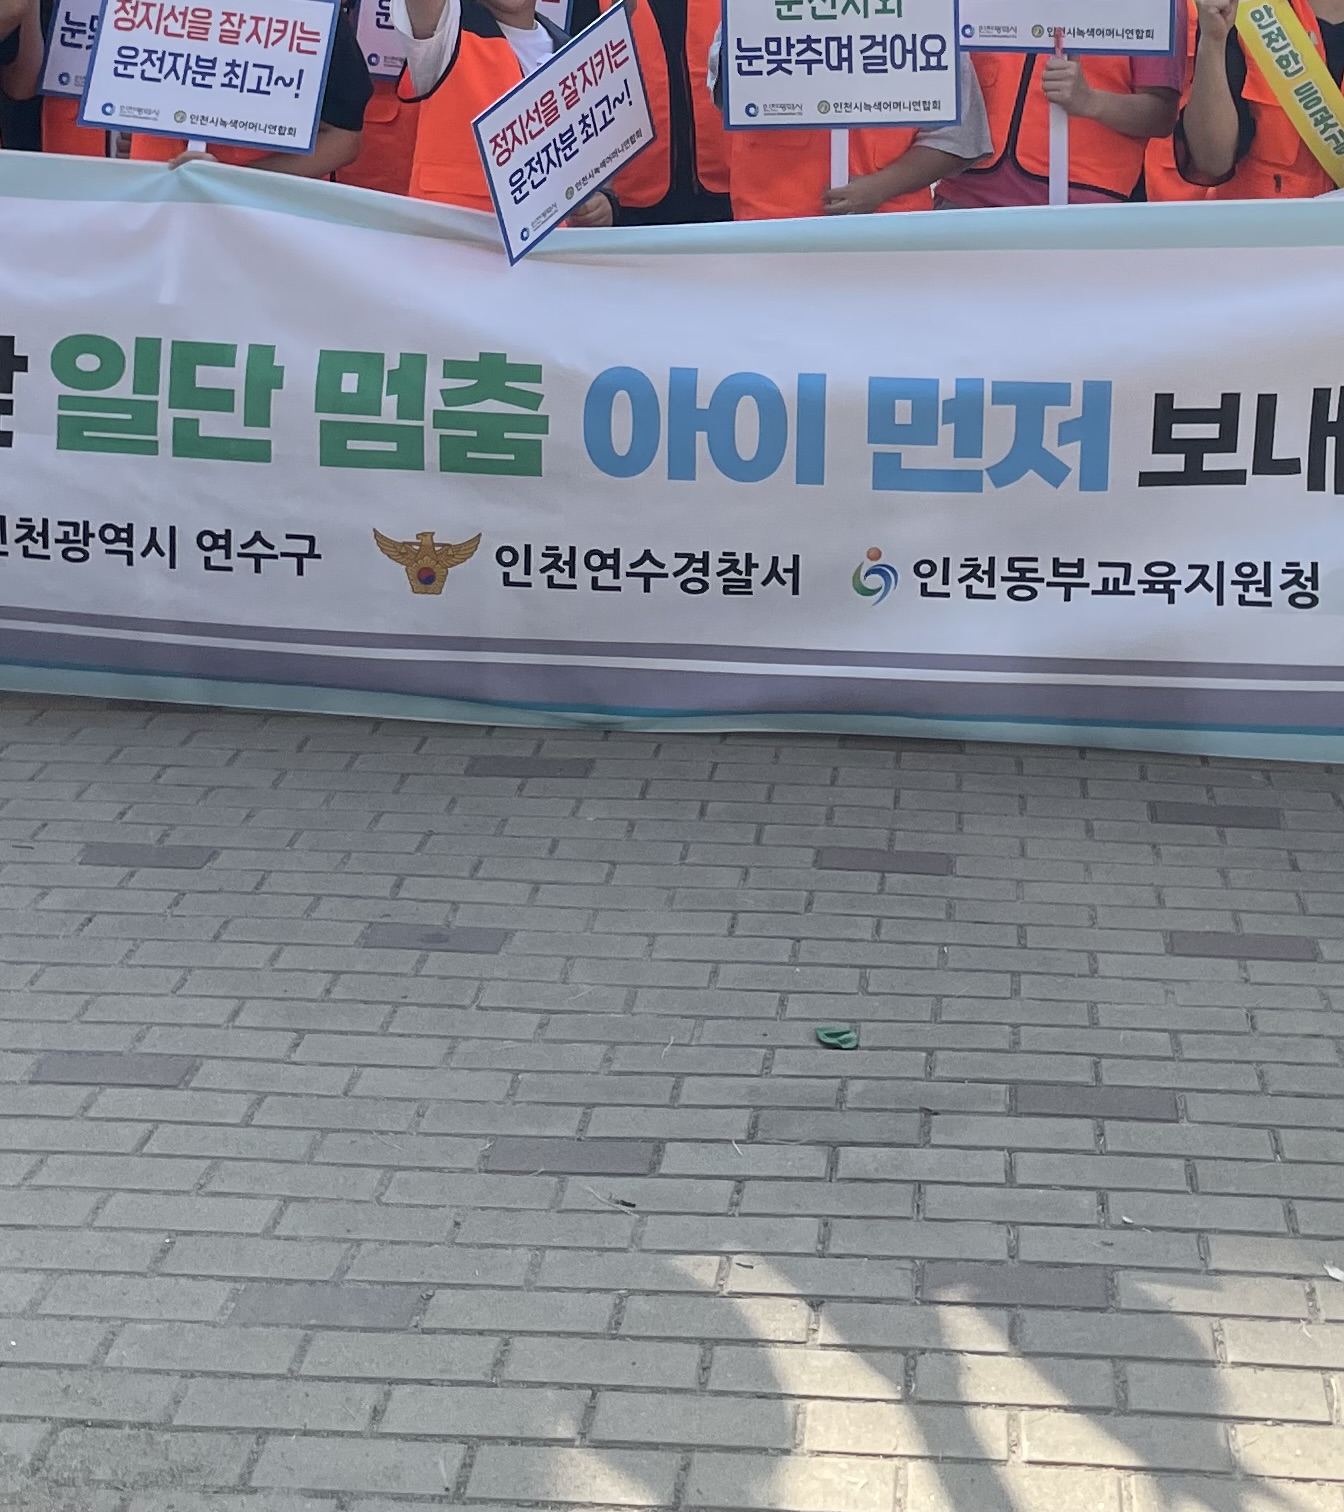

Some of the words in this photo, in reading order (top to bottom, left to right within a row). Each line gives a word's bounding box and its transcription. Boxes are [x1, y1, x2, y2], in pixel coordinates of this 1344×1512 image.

[735, 34, 854, 77] 눈맞추며
[859, 33, 949, 75] 걸어요
[1249, 3, 1305, 79] 안전한
[113, 44, 218, 90] 운전자분
[220, 58, 305, 99] 최고~!
[189, 112, 297, 138] 인천시녹색어머니연합회
[488, 88, 561, 168] 정지선을
[833, 100, 942, 114] 인천시녹색어머니연합회
[508, 123, 580, 205] 운전자분
[49, 332, 285, 464] 일단
[314, 348, 550, 478] 멈춤
[582, 365, 827, 487] 아이
[866, 374, 1114, 494] 먼저
[195, 528, 323, 578] 연수구
[494, 543, 802, 597] 인천연수경찰서
[912, 557, 1322, 612] 인천동부교육지원청
